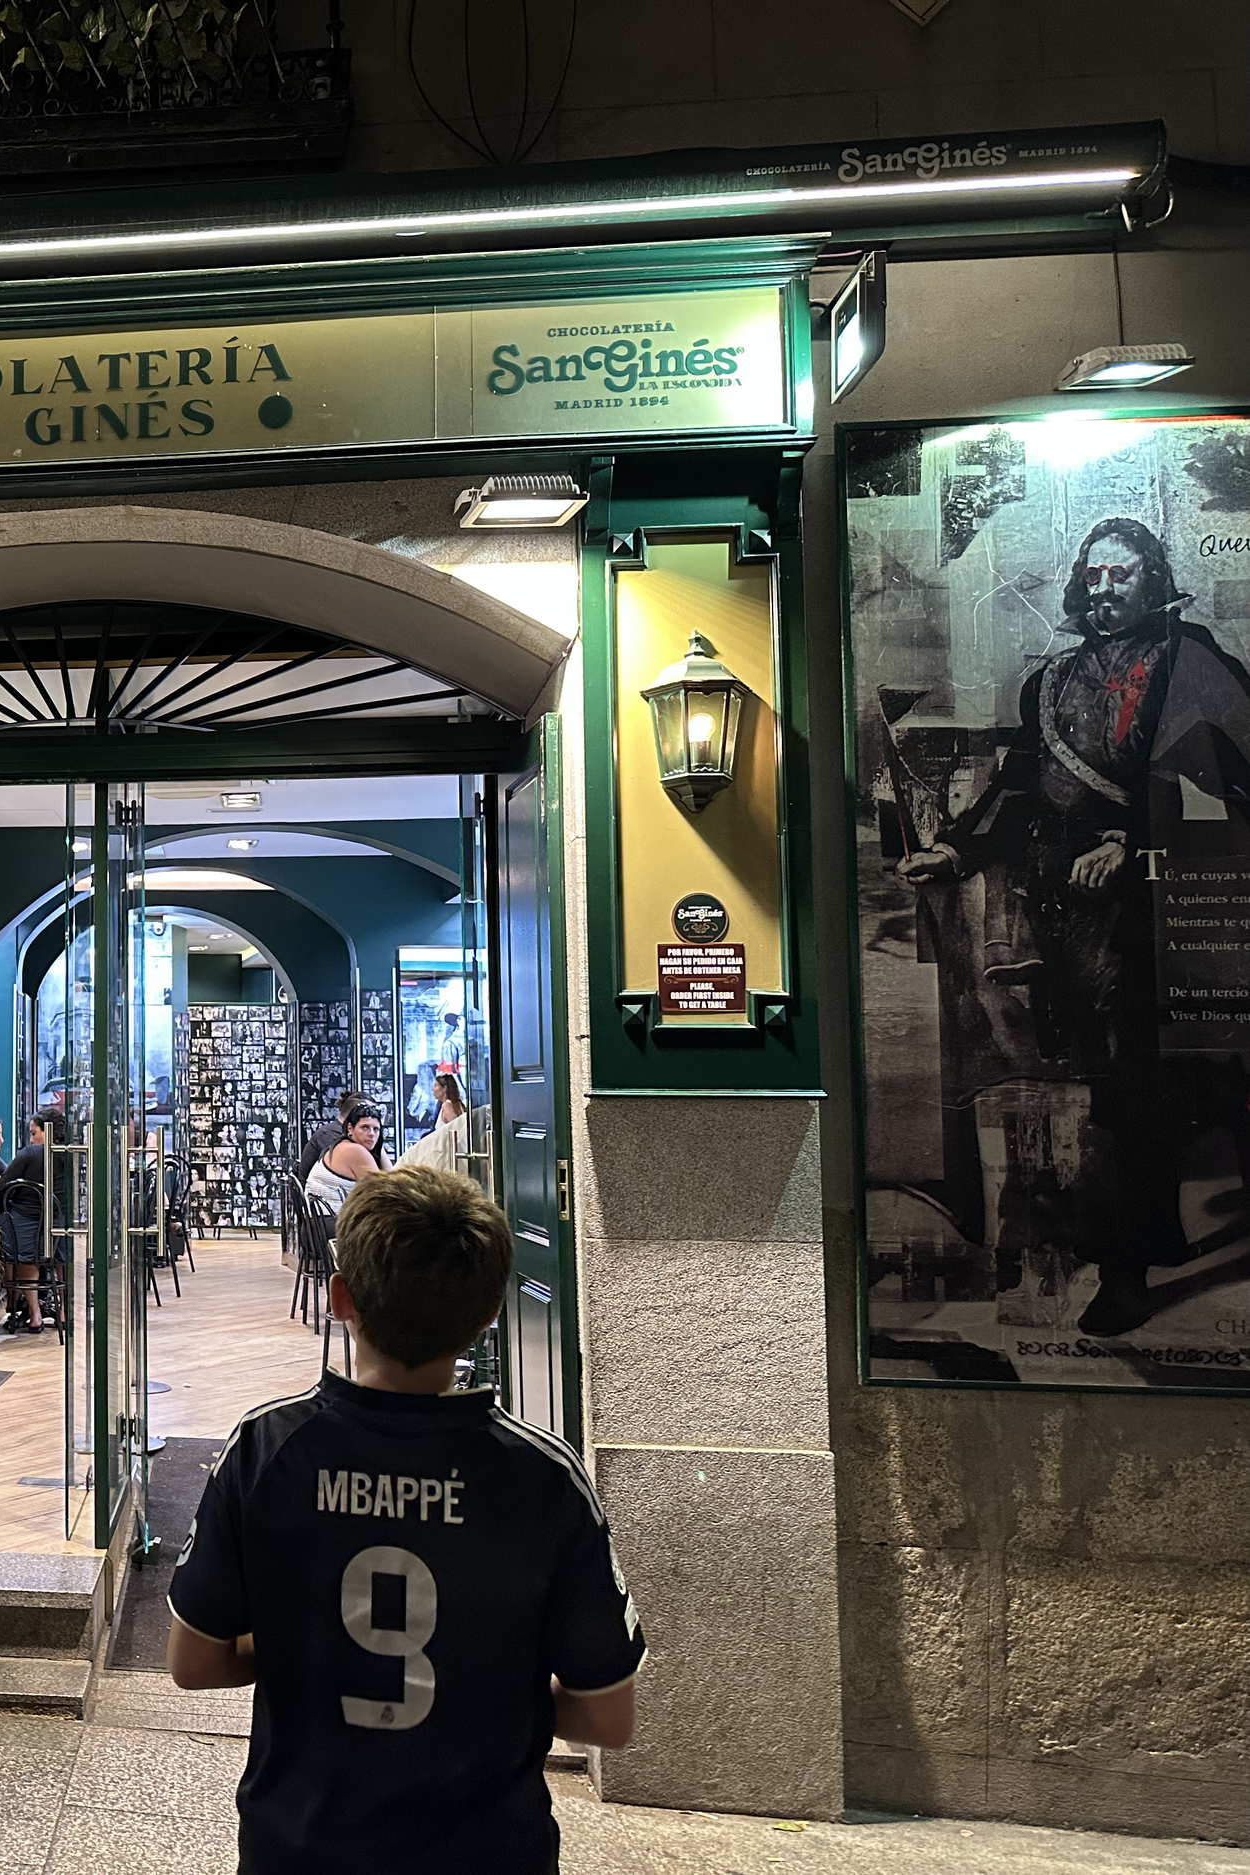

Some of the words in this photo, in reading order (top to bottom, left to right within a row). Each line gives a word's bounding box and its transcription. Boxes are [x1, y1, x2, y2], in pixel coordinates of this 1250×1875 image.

[746, 161, 831, 176] CHOCOLATERÍA
[1018, 146, 1066, 158] MADRID
[1070, 145, 1098, 155] 1894
[547, 320, 676, 338] CHOCOLATERÍA
[638, 379, 659, 391] LA
[662, 378, 743, 389] ESCONDIDA
[554, 398, 624, 411] MADRID
[629, 395, 670, 407] 1894
[24, 391, 217, 446] GINÉS
[1181, 872, 1198, 881] en
[1201, 871, 1237, 883] cuyas
[1165, 895, 1175, 904] A
[1178, 894, 1229, 906] quienes
[1166, 917, 1221, 927] Mientras
[1224, 917, 1237, 927] te
[1167, 941, 1177, 951] A
[1180, 940, 1240, 953] cualquier
[1169, 987, 1188, 997] De
[1191, 989, 1208, 997] un
[1212, 987, 1249, 998] tercio
[1170, 1010, 1198, 1021] Vive
[1202, 1010, 1231, 1021] Dios
[1216, 1319, 1250, 1334] CH
[317, 1469, 465, 1524] MBAPPÉ
[341, 1545, 438, 1730] 9
